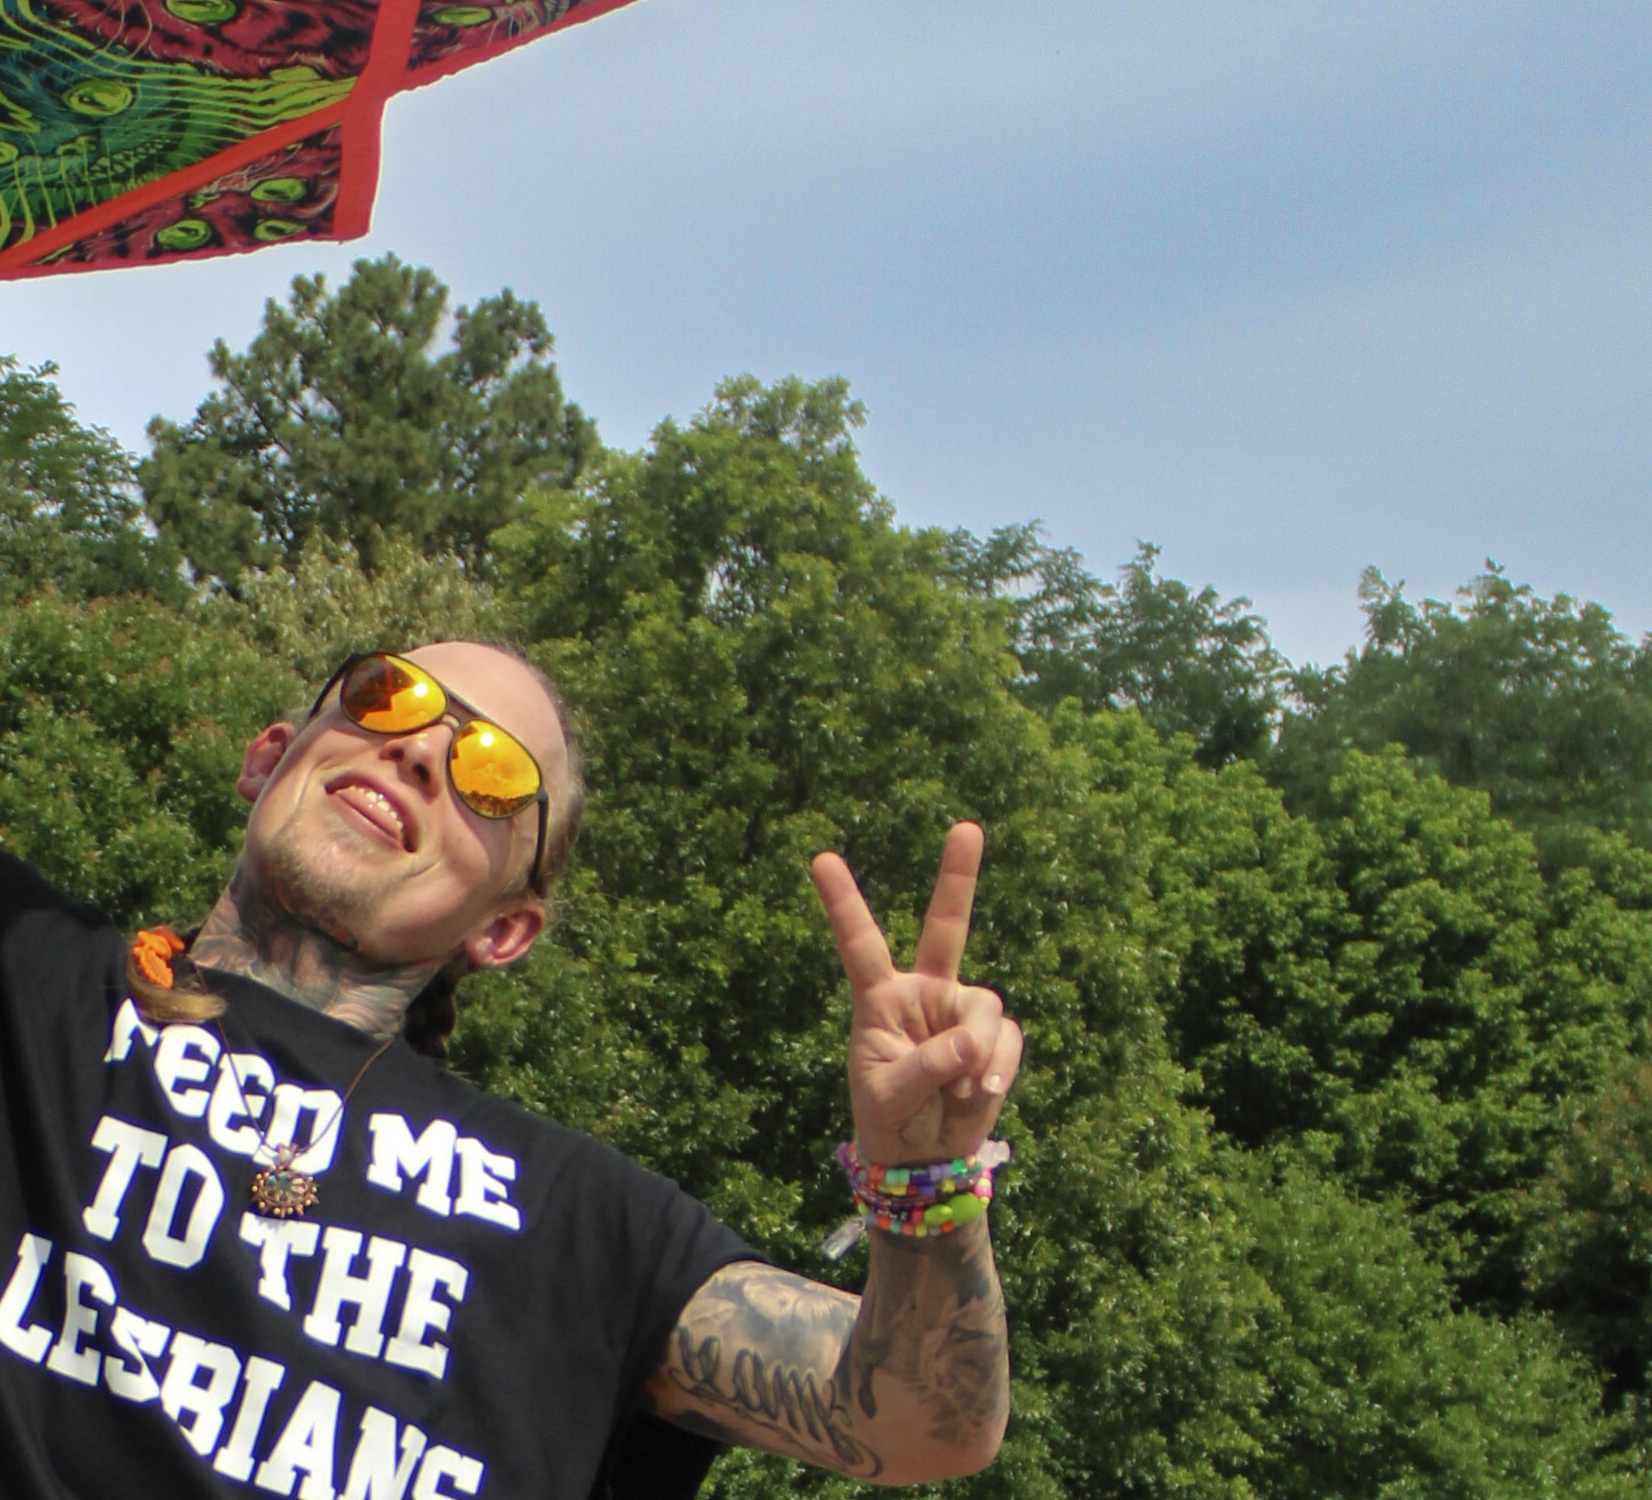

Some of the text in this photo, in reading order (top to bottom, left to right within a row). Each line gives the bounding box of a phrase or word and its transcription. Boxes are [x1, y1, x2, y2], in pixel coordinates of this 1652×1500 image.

[82, 1115, 470, 1380] TO THE
[367, 1111, 522, 1231] ME
